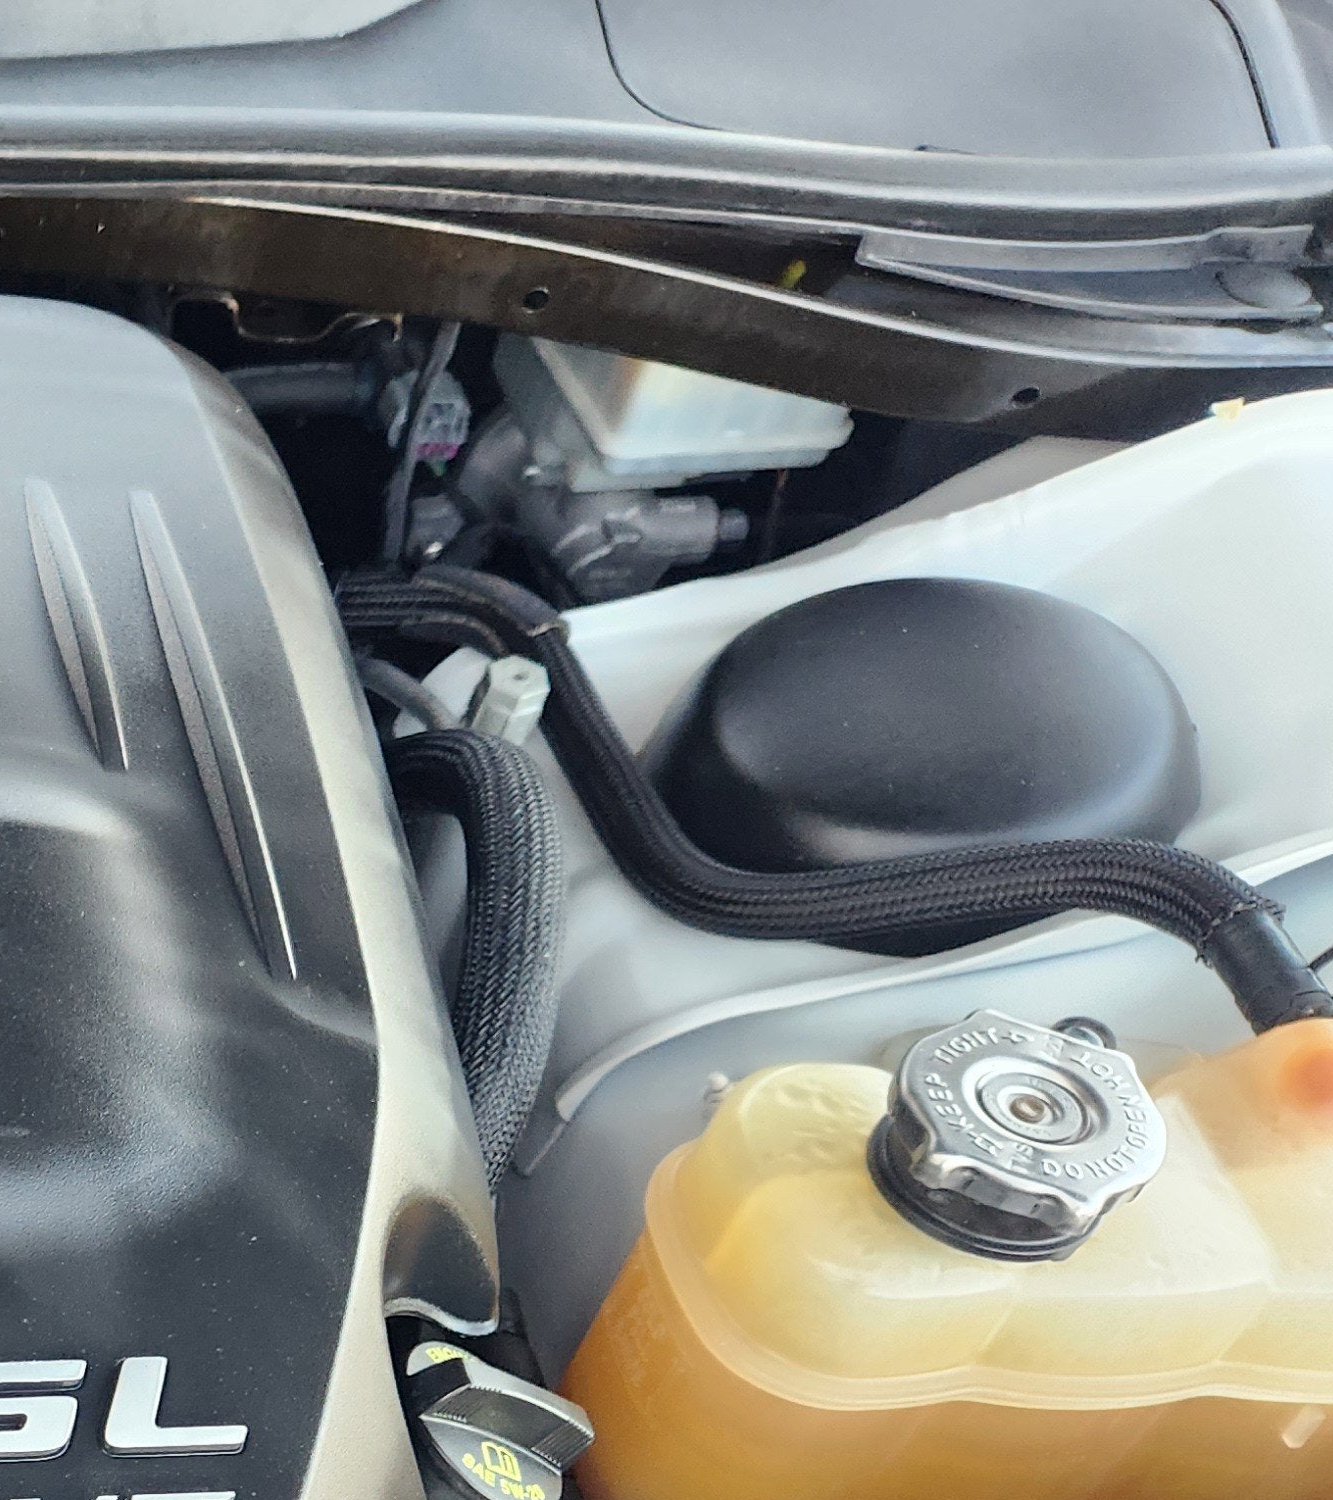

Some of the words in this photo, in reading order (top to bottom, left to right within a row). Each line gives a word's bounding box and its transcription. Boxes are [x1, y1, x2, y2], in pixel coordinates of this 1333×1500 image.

[934, 1026, 998, 1065] TIGHT
[1070, 1050, 1132, 1092] HOT
[924, 1072, 975, 1134] KEEP
[1119, 1093, 1148, 1149] OPEN
[1041, 1157, 1084, 1180] DO
[1085, 1144, 1136, 1180] NOT
[461, 1452, 496, 1488] SAE
